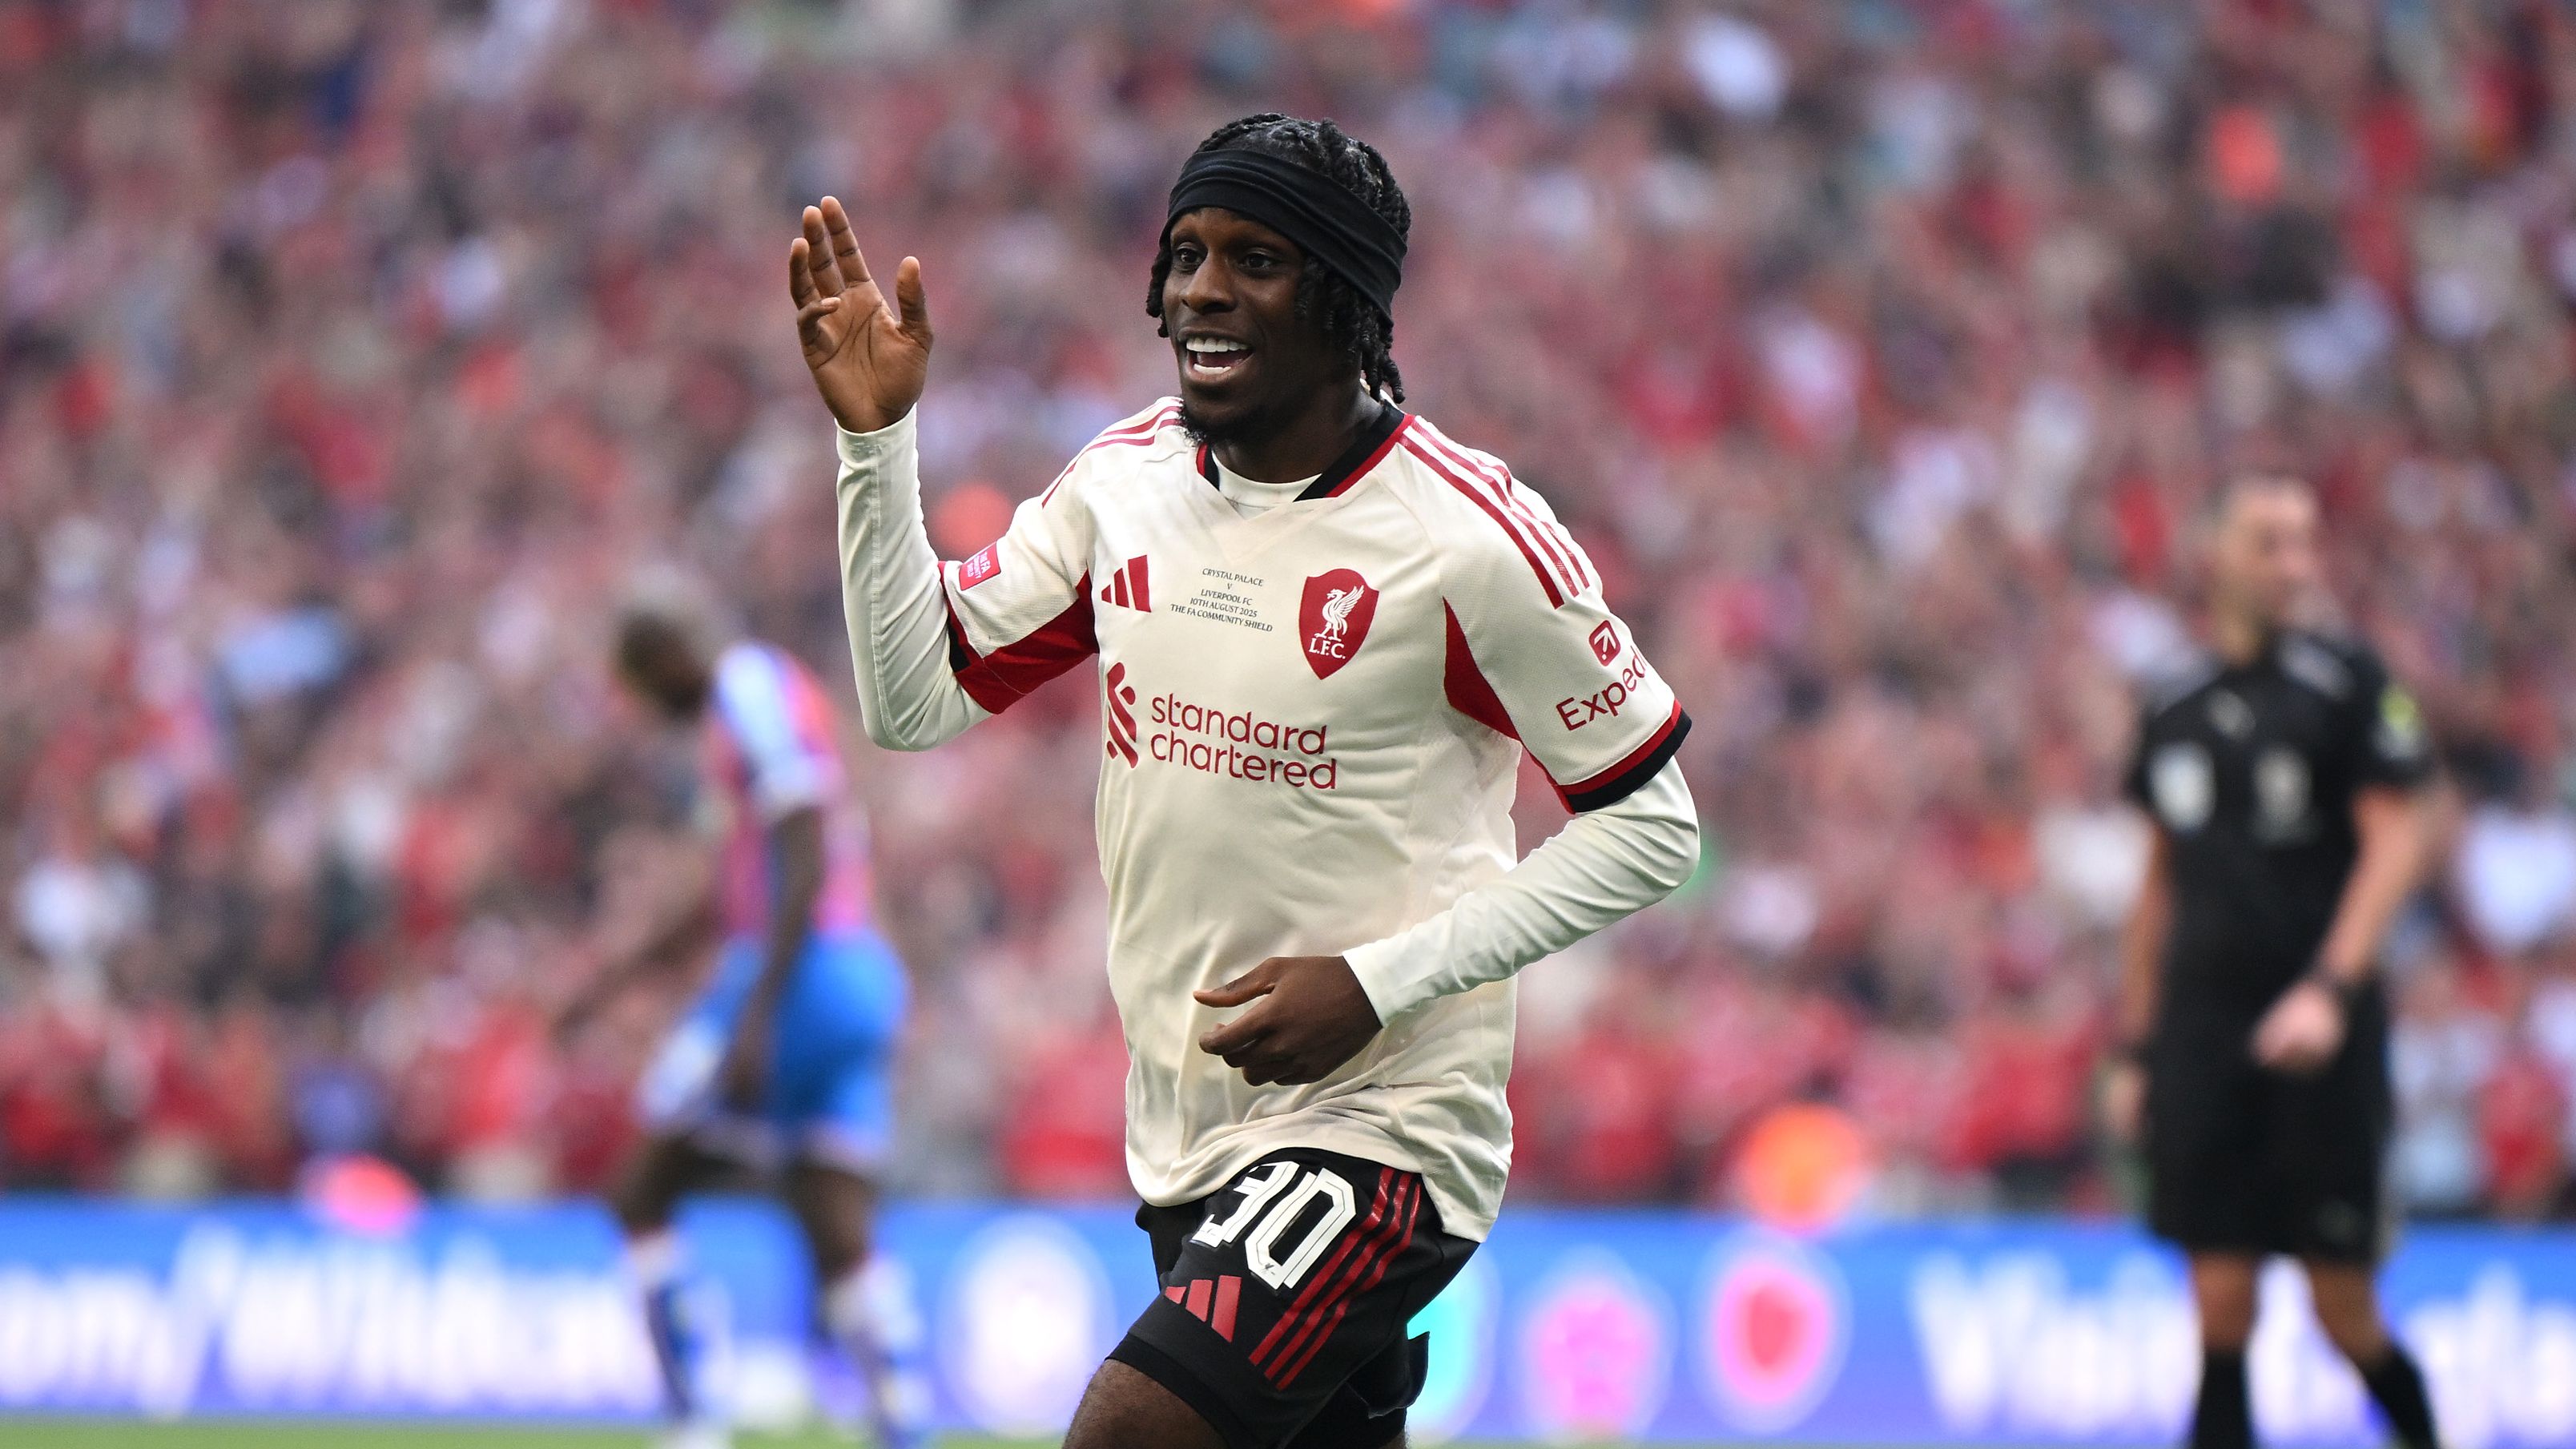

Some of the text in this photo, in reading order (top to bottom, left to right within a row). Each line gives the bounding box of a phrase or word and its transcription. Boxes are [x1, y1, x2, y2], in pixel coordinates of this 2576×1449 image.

[980, 560, 991, 574] FA
[1202, 568, 1264, 587] CRYSTAL PALACE
[1227, 582, 1233, 590] V
[1190, 597, 1258, 618] 10TH AUGUST 2025
[1201, 589, 1253, 606] LIVERPOOL FC
[1170, 603, 1273, 632] THE FA COMMUNITY SHIELD
[1309, 638, 1346, 659] L.F.C.
[1556, 645, 1647, 731] Exped
[1151, 693, 1327, 755] standard
[1150, 730, 1337, 789] chartered
[1191, 1161, 1357, 1290] 30
